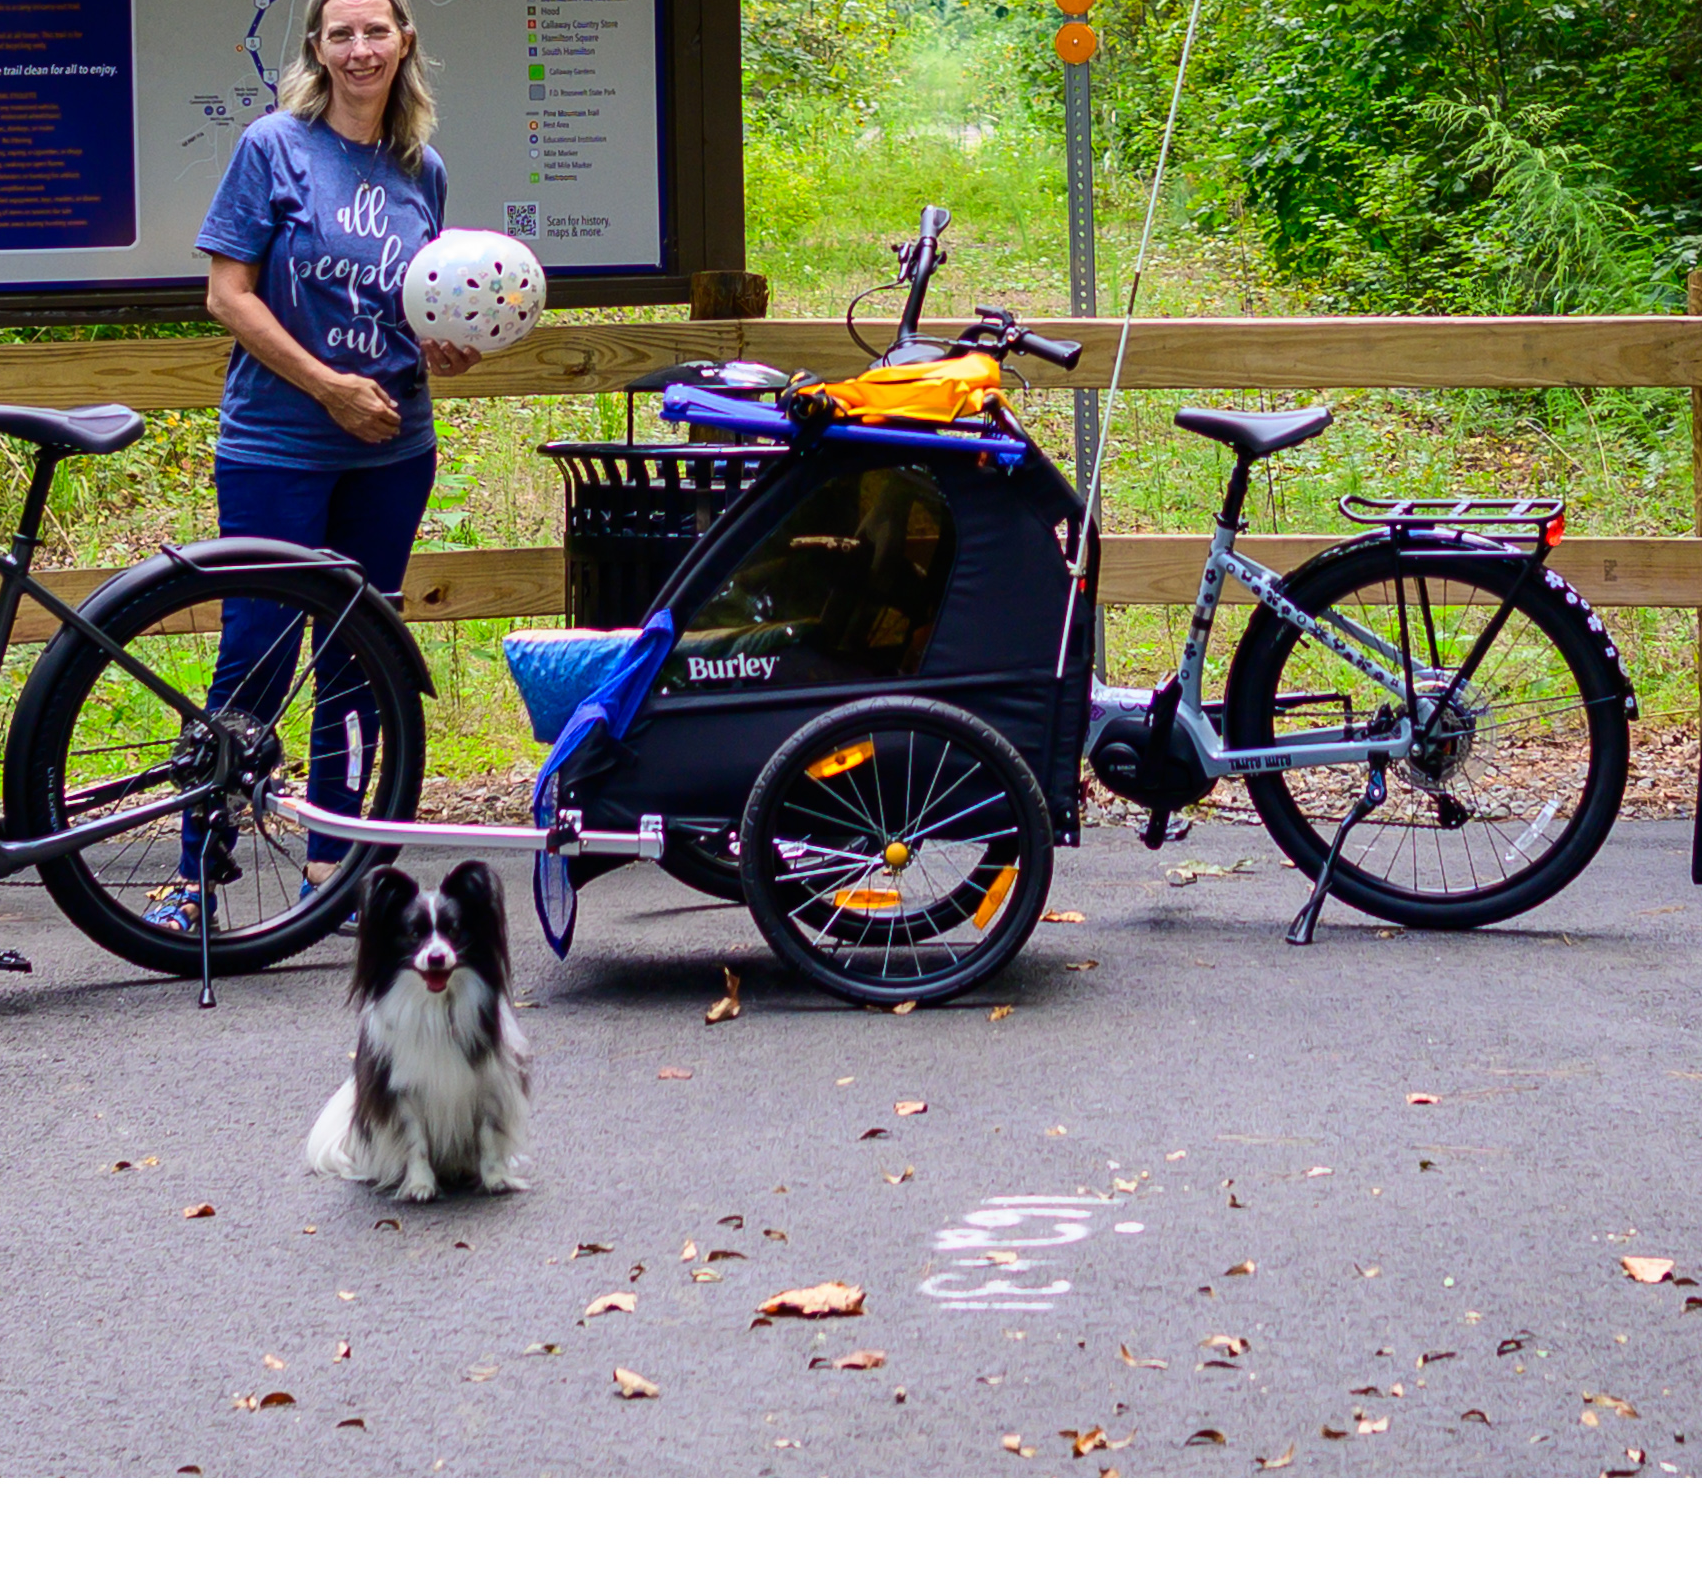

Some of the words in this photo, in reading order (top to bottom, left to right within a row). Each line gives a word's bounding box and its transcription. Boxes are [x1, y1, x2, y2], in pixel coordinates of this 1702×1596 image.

[541, 6, 560, 15] Hood
[541, 20, 570, 30] Callaway
[573, 20, 599, 30] Country
[600, 19, 618, 28] Store
[542, 34, 573, 42] Hamilton
[575, 33, 599, 44] Square
[542, 47, 562, 55] South
[563, 47, 595, 55] Hamilton
[3, 65, 23, 75] trail
[24, 65, 48, 75] clean
[50, 64, 64, 74] for
[65, 64, 78, 74] all
[79, 65, 89, 74] to
[90, 64, 118, 77] enjoy.
[337, 186, 389, 238] all
[547, 215, 566, 226] Scan
[568, 214, 579, 226] for
[581, 215, 611, 228] history,
[547, 229, 569, 240] maps
[572, 226, 578, 236] &
[289, 236, 408, 315] people
[327, 309, 393, 359] out
[688, 652, 776, 680] Burley
